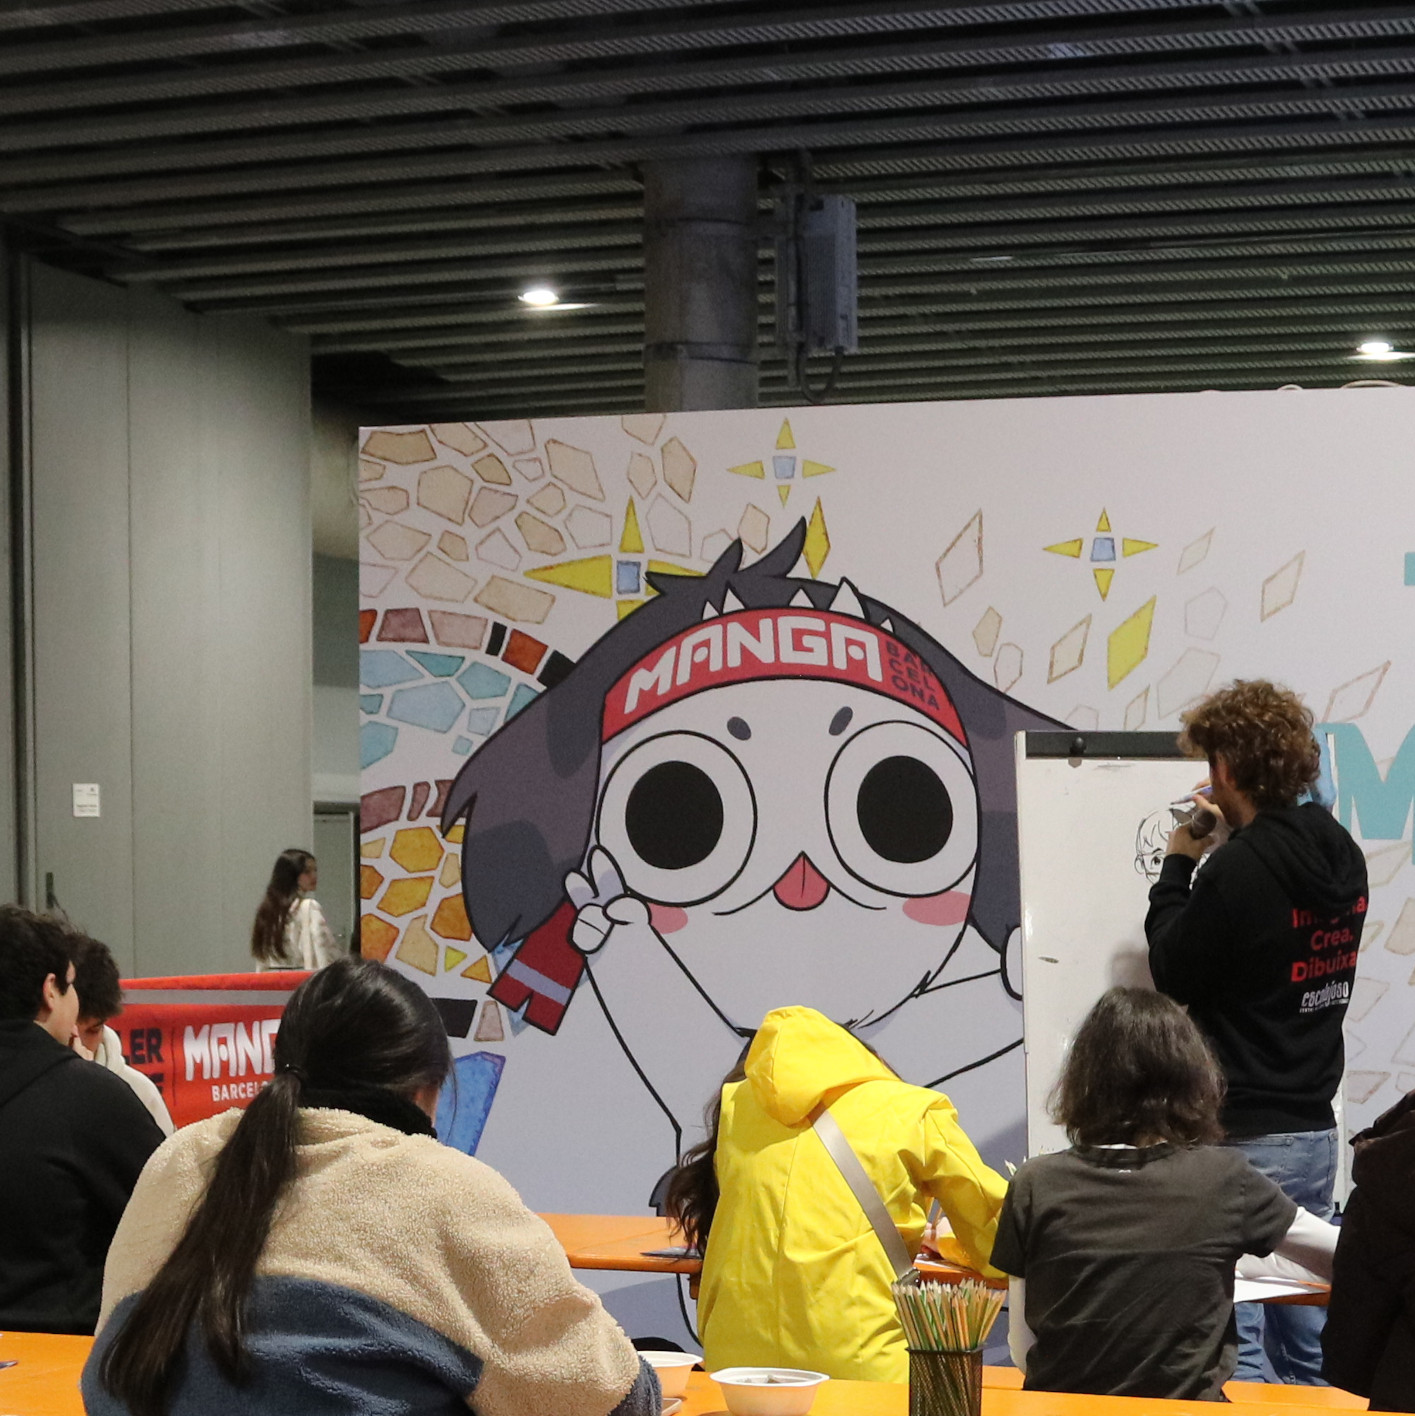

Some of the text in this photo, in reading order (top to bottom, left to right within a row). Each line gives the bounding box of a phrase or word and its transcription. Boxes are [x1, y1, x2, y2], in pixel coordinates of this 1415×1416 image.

[623, 615, 884, 715] MANGA
[182, 1019, 282, 1082] MANG
[211, 1080, 269, 1103] BARCEL
